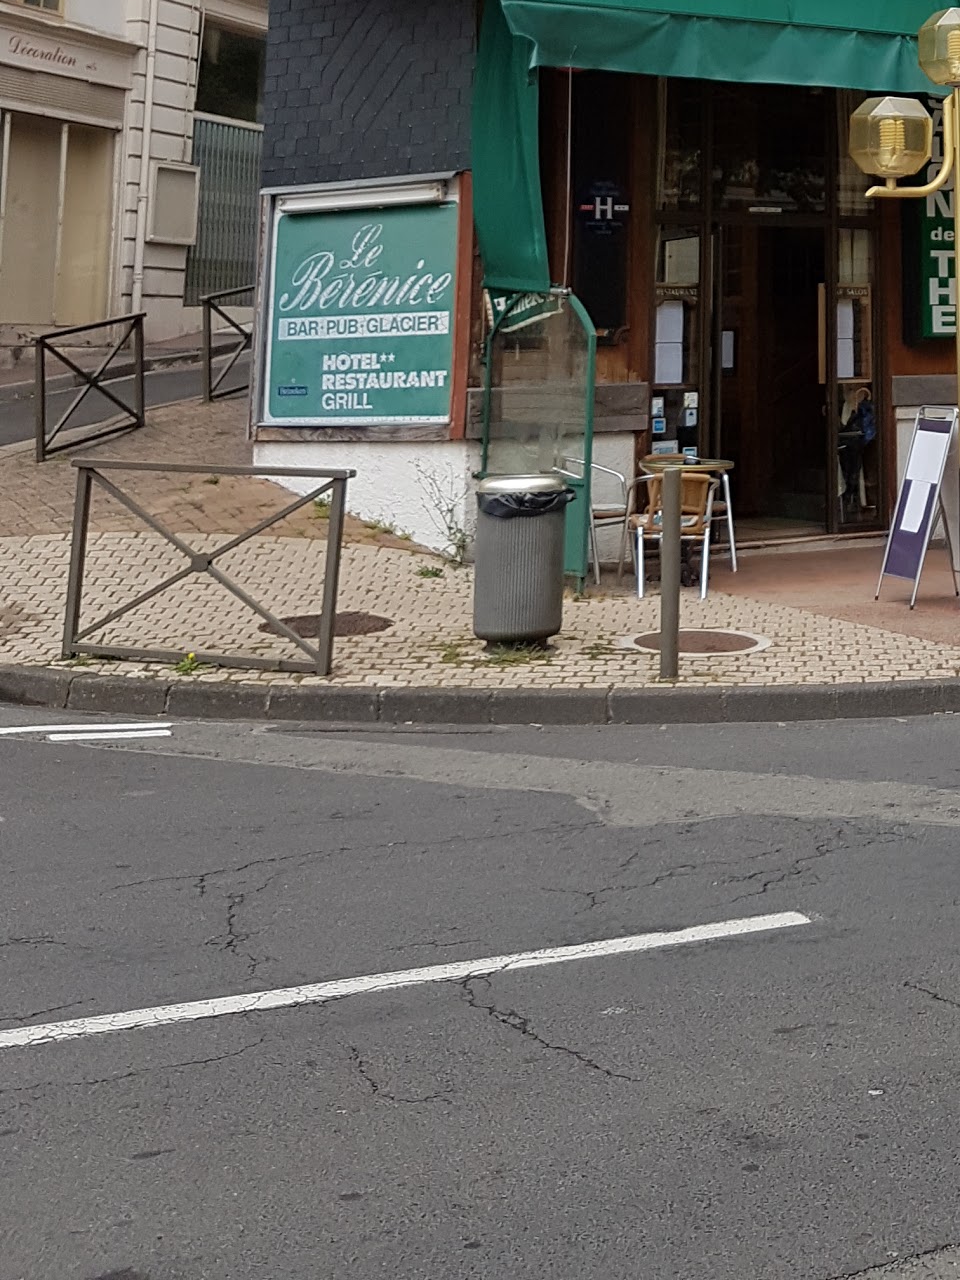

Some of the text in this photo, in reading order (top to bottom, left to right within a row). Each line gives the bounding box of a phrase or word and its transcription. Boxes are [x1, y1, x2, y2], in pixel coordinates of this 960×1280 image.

[8, 35, 77, 67] Décoration
[595, 196, 613, 220] H
[339, 223, 384, 269] Le
[930, 226, 955, 241] de
[279, 250, 452, 312] Bérénice
[929, 250, 957, 333] THE
[321, 370, 448, 390] RESTAURANT
[321, 392, 373, 410] GRILL
